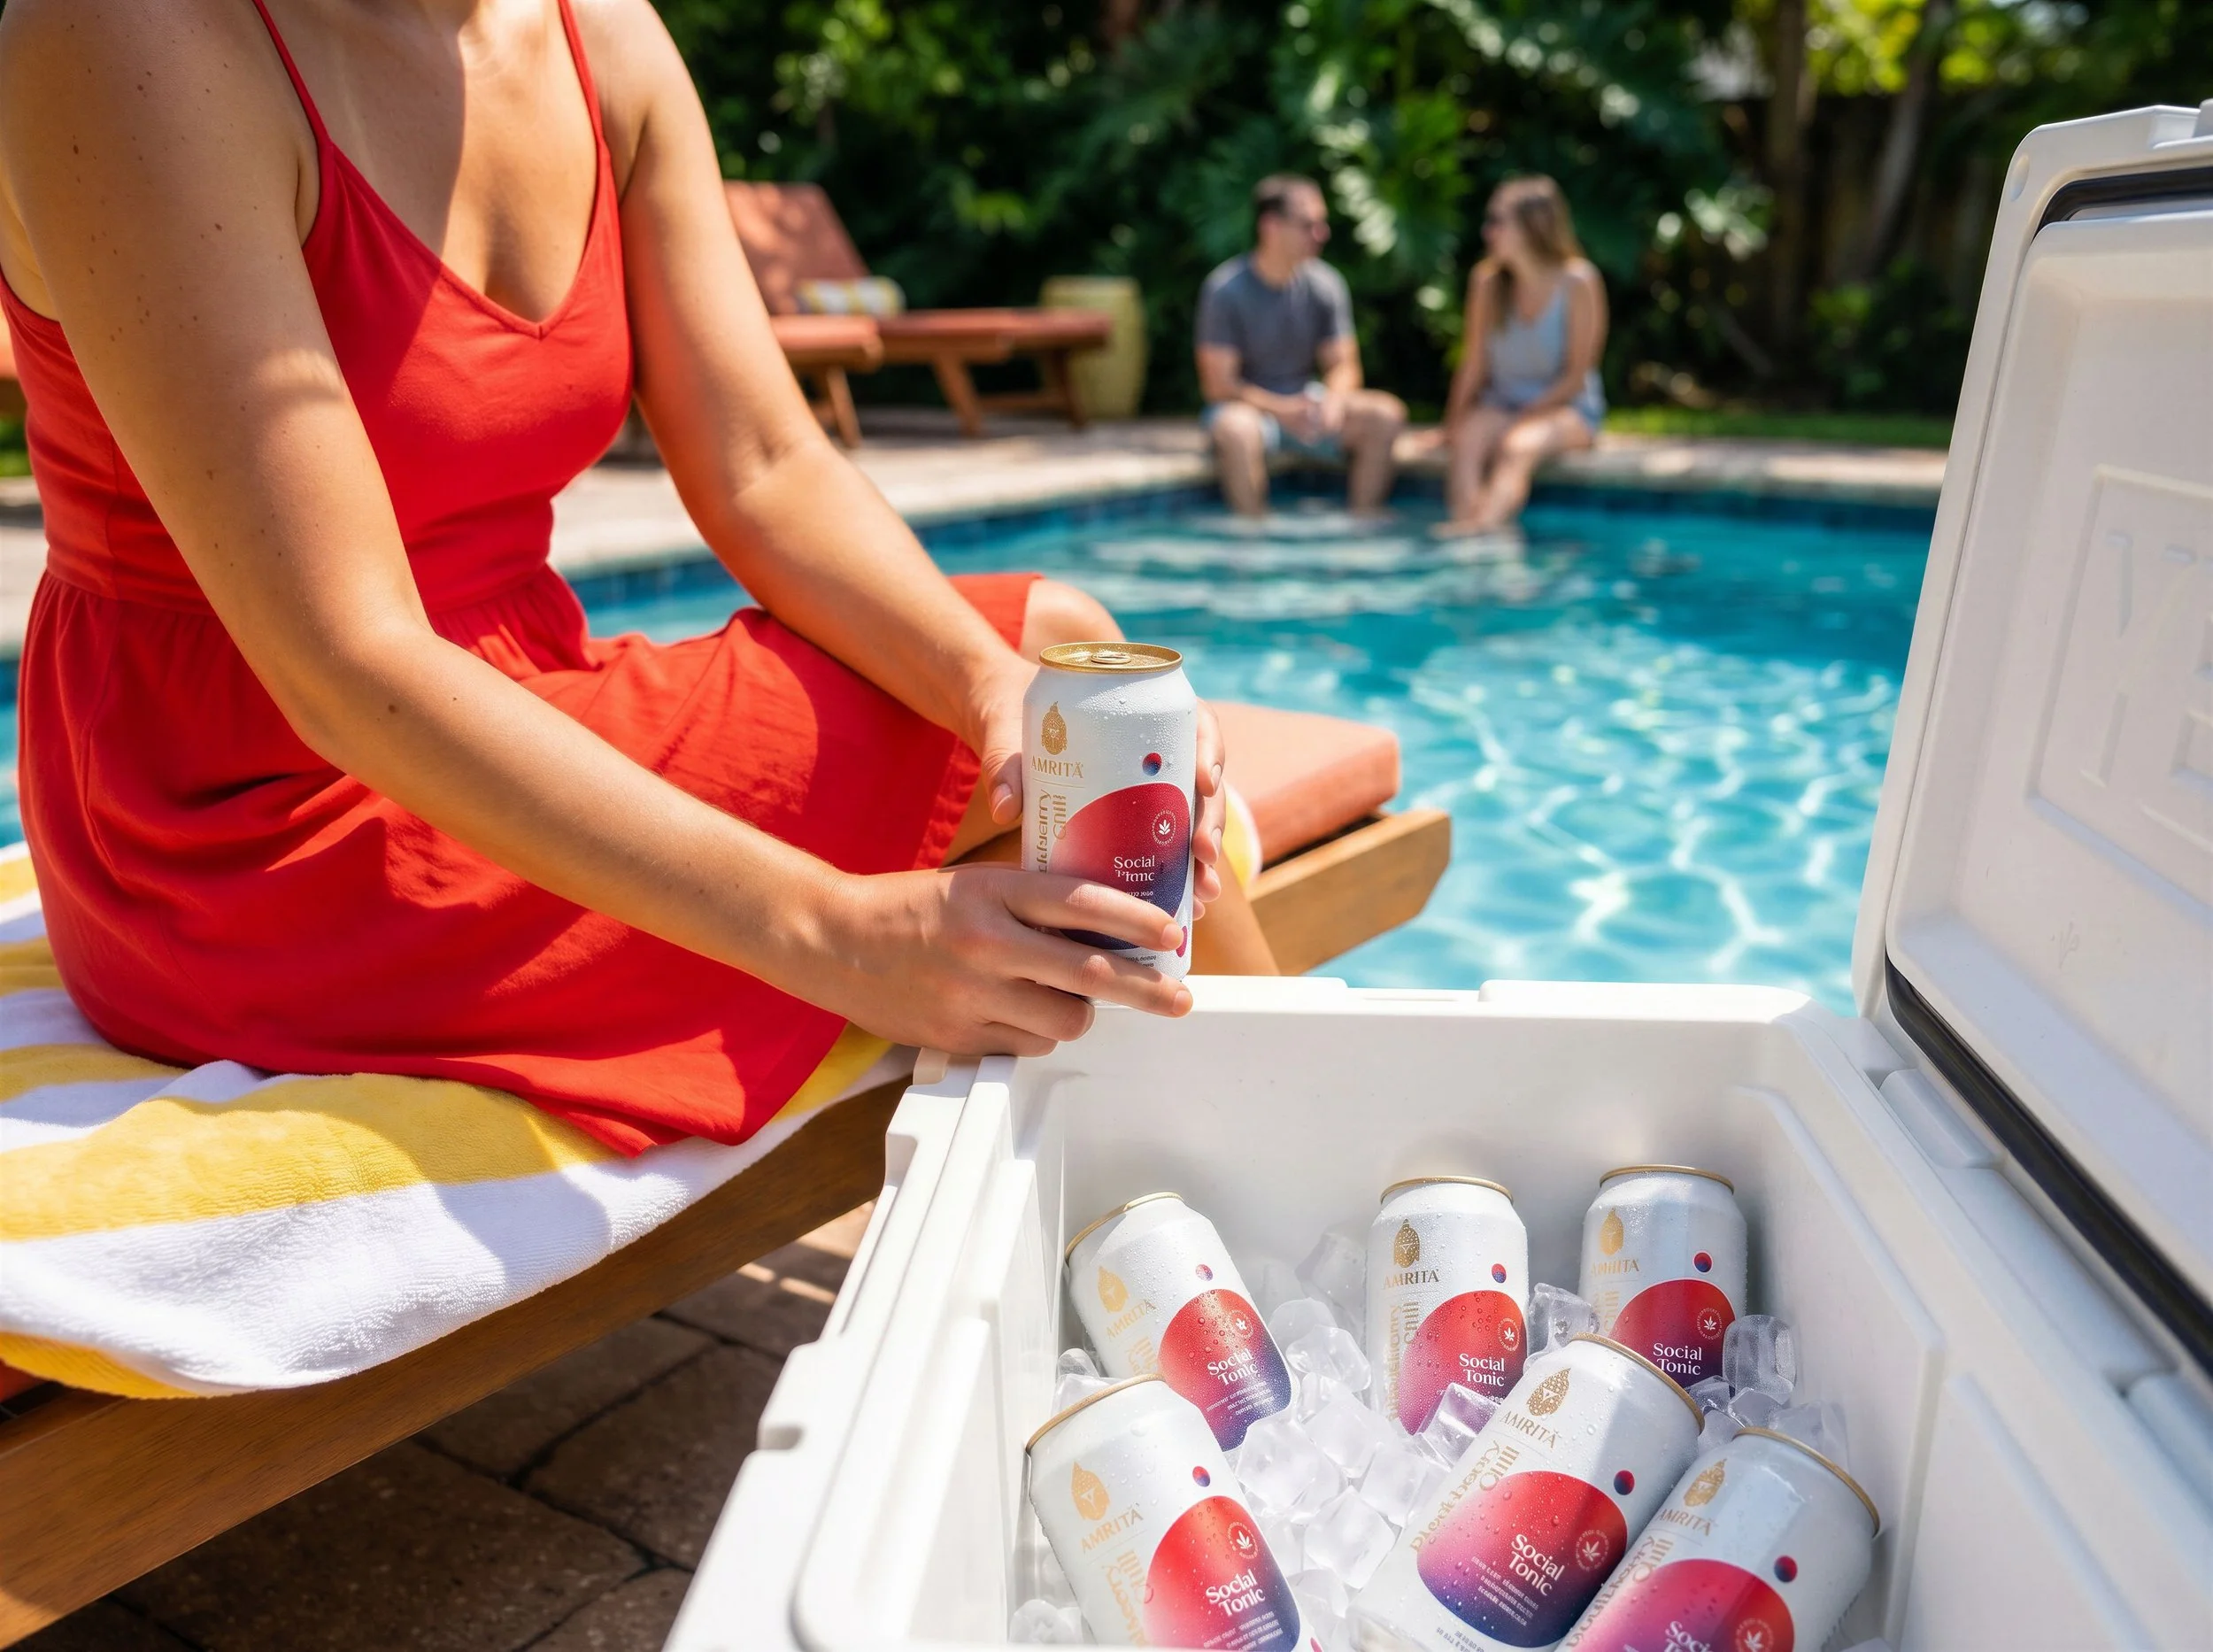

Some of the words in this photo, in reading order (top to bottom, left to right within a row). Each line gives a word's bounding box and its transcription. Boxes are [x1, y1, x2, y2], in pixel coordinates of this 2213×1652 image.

[1114, 855, 1155, 869] Social
[1207, 1348, 1254, 1376] Social
[1459, 1353, 1505, 1371] Social
[1653, 1343, 1702, 1361] Social
[1217, 1362, 1259, 1386] Tonic
[1463, 1370, 1505, 1386] Tonic
[1657, 1358, 1701, 1375] Tonic
[1511, 1533, 1565, 1581] Social
[1508, 1551, 1553, 1596] Tonic
[1205, 1568, 1258, 1605] Social
[1218, 1587, 1266, 1617] Tonic
